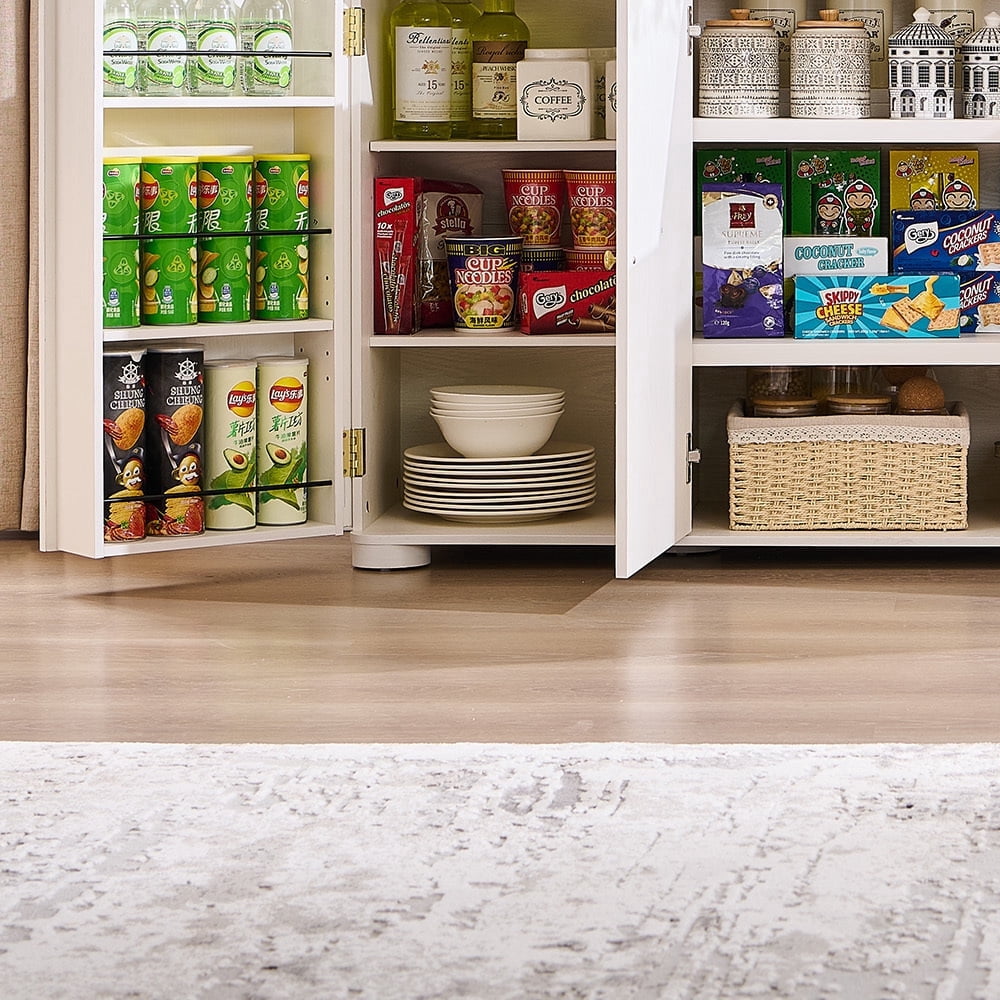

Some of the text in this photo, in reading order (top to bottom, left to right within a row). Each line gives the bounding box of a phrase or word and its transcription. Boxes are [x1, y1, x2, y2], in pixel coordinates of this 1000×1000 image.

[427, 80, 438, 90] 15
[454, 80, 465, 90] 15
[534, 96, 572, 104] COFFEE
[521, 185, 549, 196] CUP
[577, 186, 604, 197] CUP
[512, 195, 556, 206] NOODLES
[570, 196, 613, 207] NOODLES
[376, 222, 392, 230] 10x
[440, 218, 466, 229] stella
[943, 215, 994, 249] COCONUT
[948, 231, 988, 254] CRACKERS
[464, 244, 506, 256] BIG
[795, 244, 854, 260] COCONUT
[467, 257, 503, 271] CUP
[818, 257, 865, 270] CRACKER
[456, 270, 512, 284] NOODLES
[825, 290, 860, 306] SKIPPY
[816, 304, 863, 319] CHEESE
